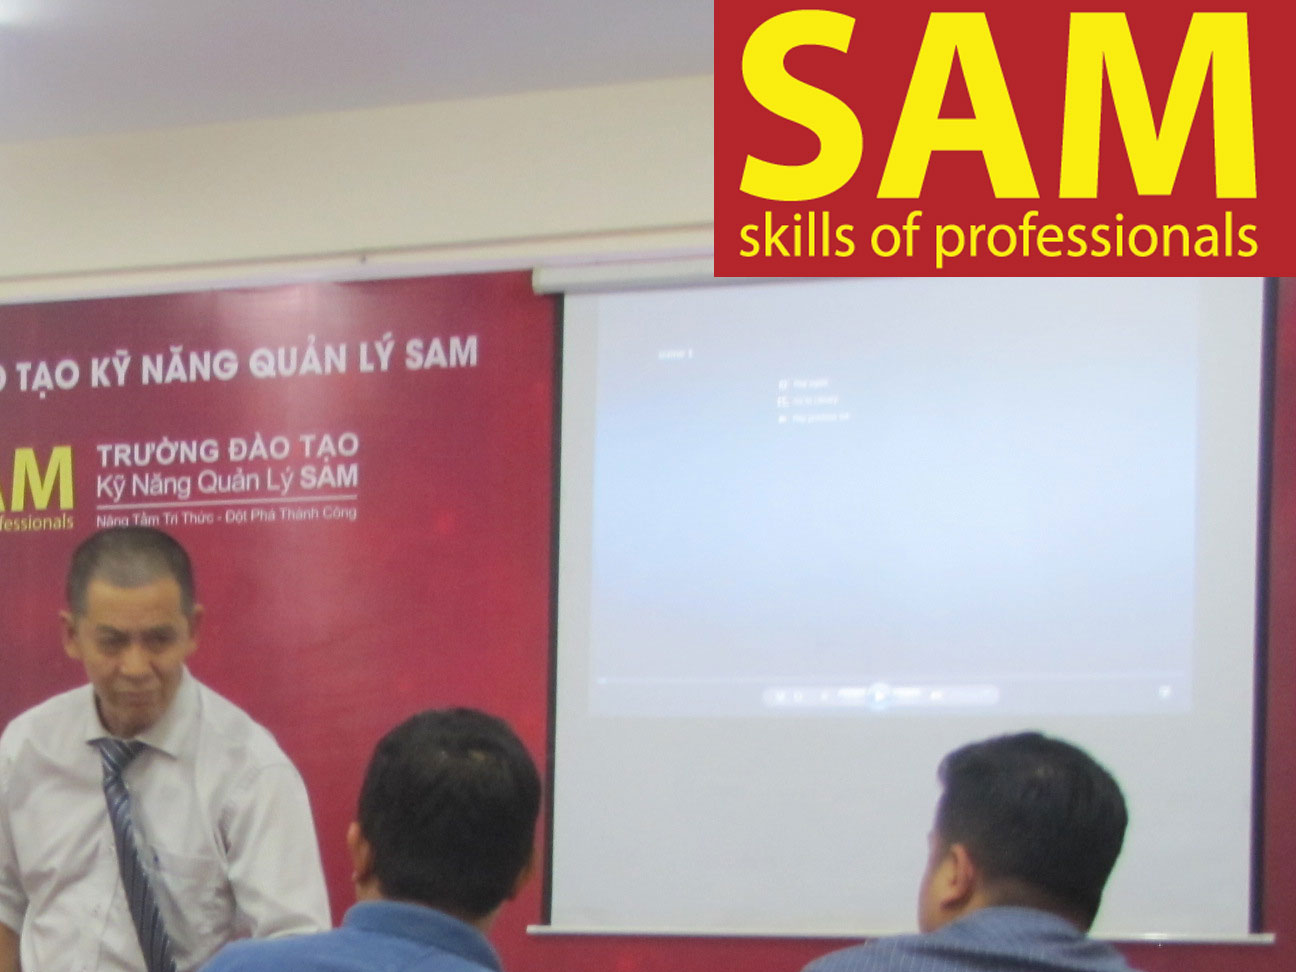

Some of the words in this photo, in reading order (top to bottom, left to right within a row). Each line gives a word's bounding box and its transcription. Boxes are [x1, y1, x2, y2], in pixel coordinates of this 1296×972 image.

[15, 358, 80, 399] TẠO
[90, 348, 132, 388] KỸ
[141, 344, 239, 386] NĂNG
[248, 333, 347, 379] QUẢN
[359, 331, 396, 374] LÝ
[404, 334, 479, 371] SAM
[96, 436, 220, 468] TRƯỜNG
[228, 431, 290, 463] ĐÀO
[299, 432, 359, 463] TẠO
[96, 474, 126, 503] Kỹ
[132, 472, 191, 500] Năng
[197, 466, 260, 494] Quản
[267, 466, 294, 496] Lý
[299, 463, 359, 490] SAM
